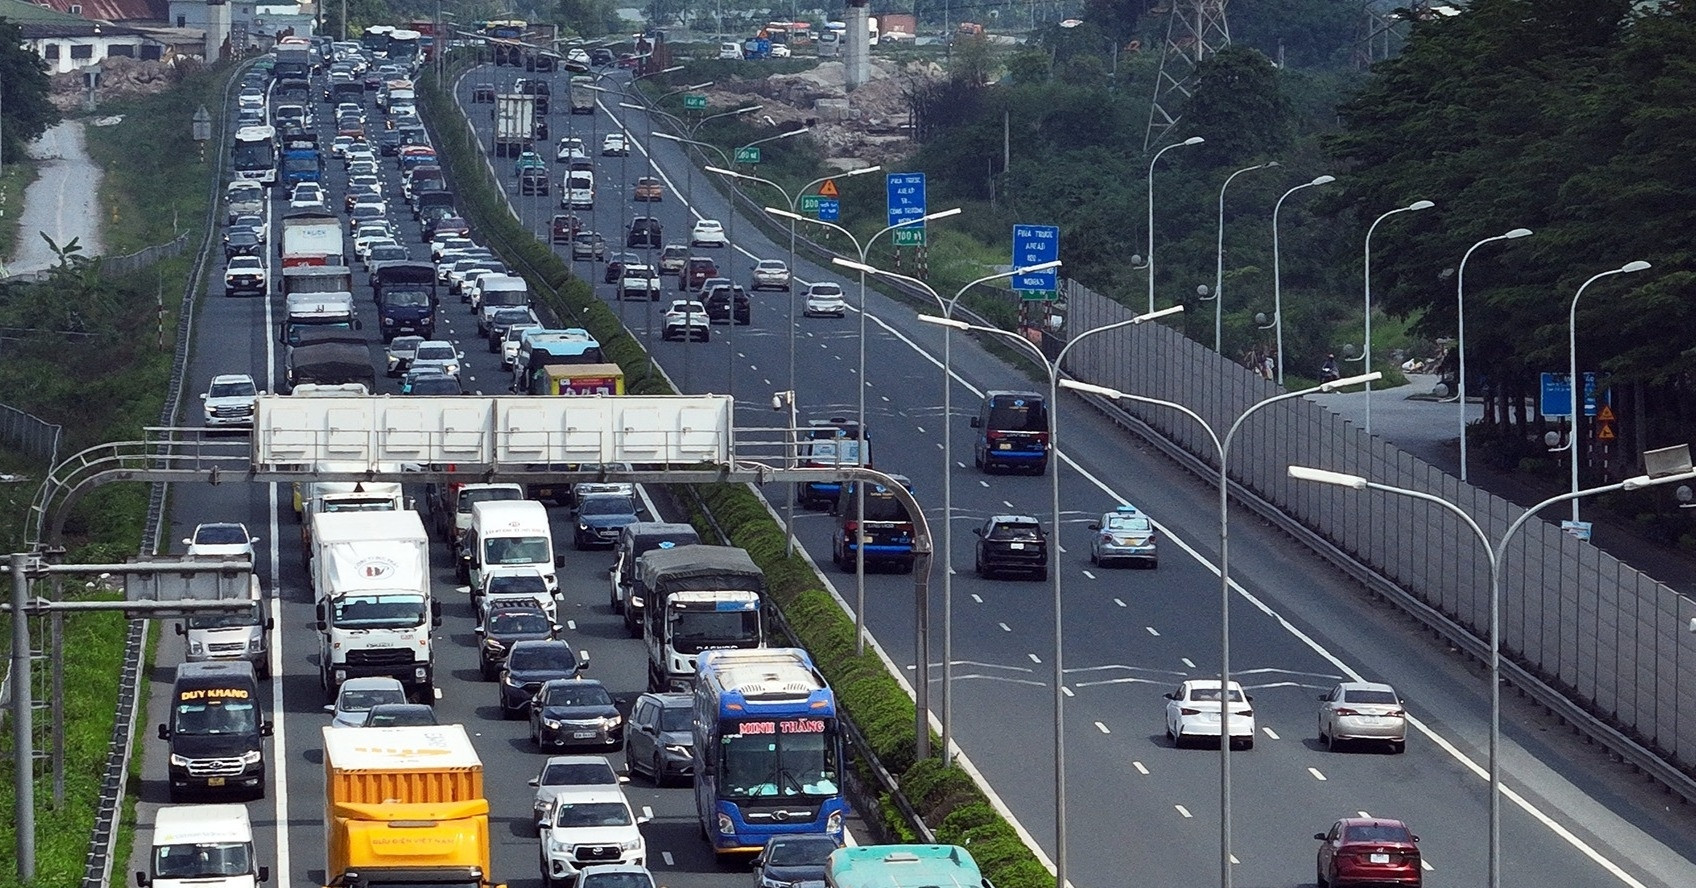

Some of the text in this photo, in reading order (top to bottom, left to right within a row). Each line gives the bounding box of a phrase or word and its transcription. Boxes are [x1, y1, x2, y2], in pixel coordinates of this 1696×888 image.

[181, 688, 249, 700] DUY KHANG
[739, 721, 775, 734] MINH
